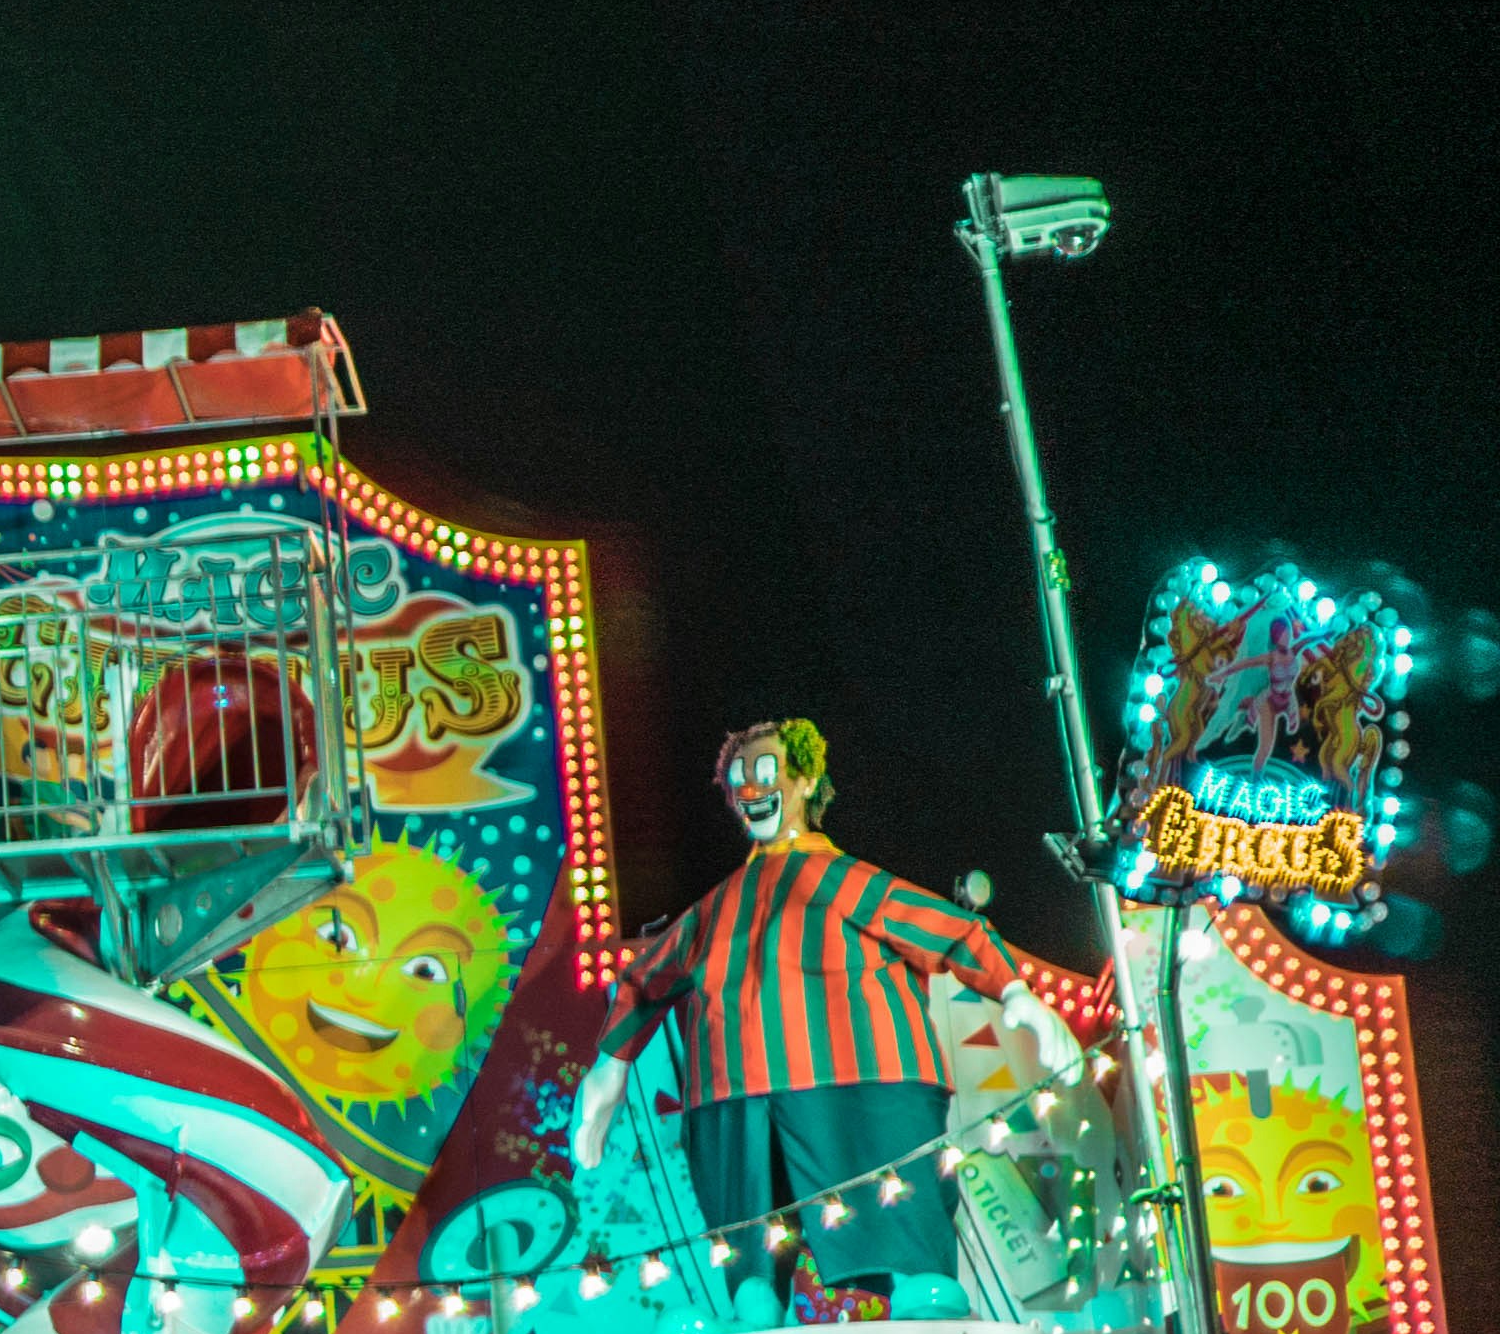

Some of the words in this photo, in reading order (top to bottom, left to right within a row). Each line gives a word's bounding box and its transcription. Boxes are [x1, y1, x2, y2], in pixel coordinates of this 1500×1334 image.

[1195, 764, 1331, 823] MAGIC
[1139, 785, 1365, 891] CIRCUS
[974, 1179, 1038, 1265] TICKET
[1231, 1277, 1337, 1330] 100
